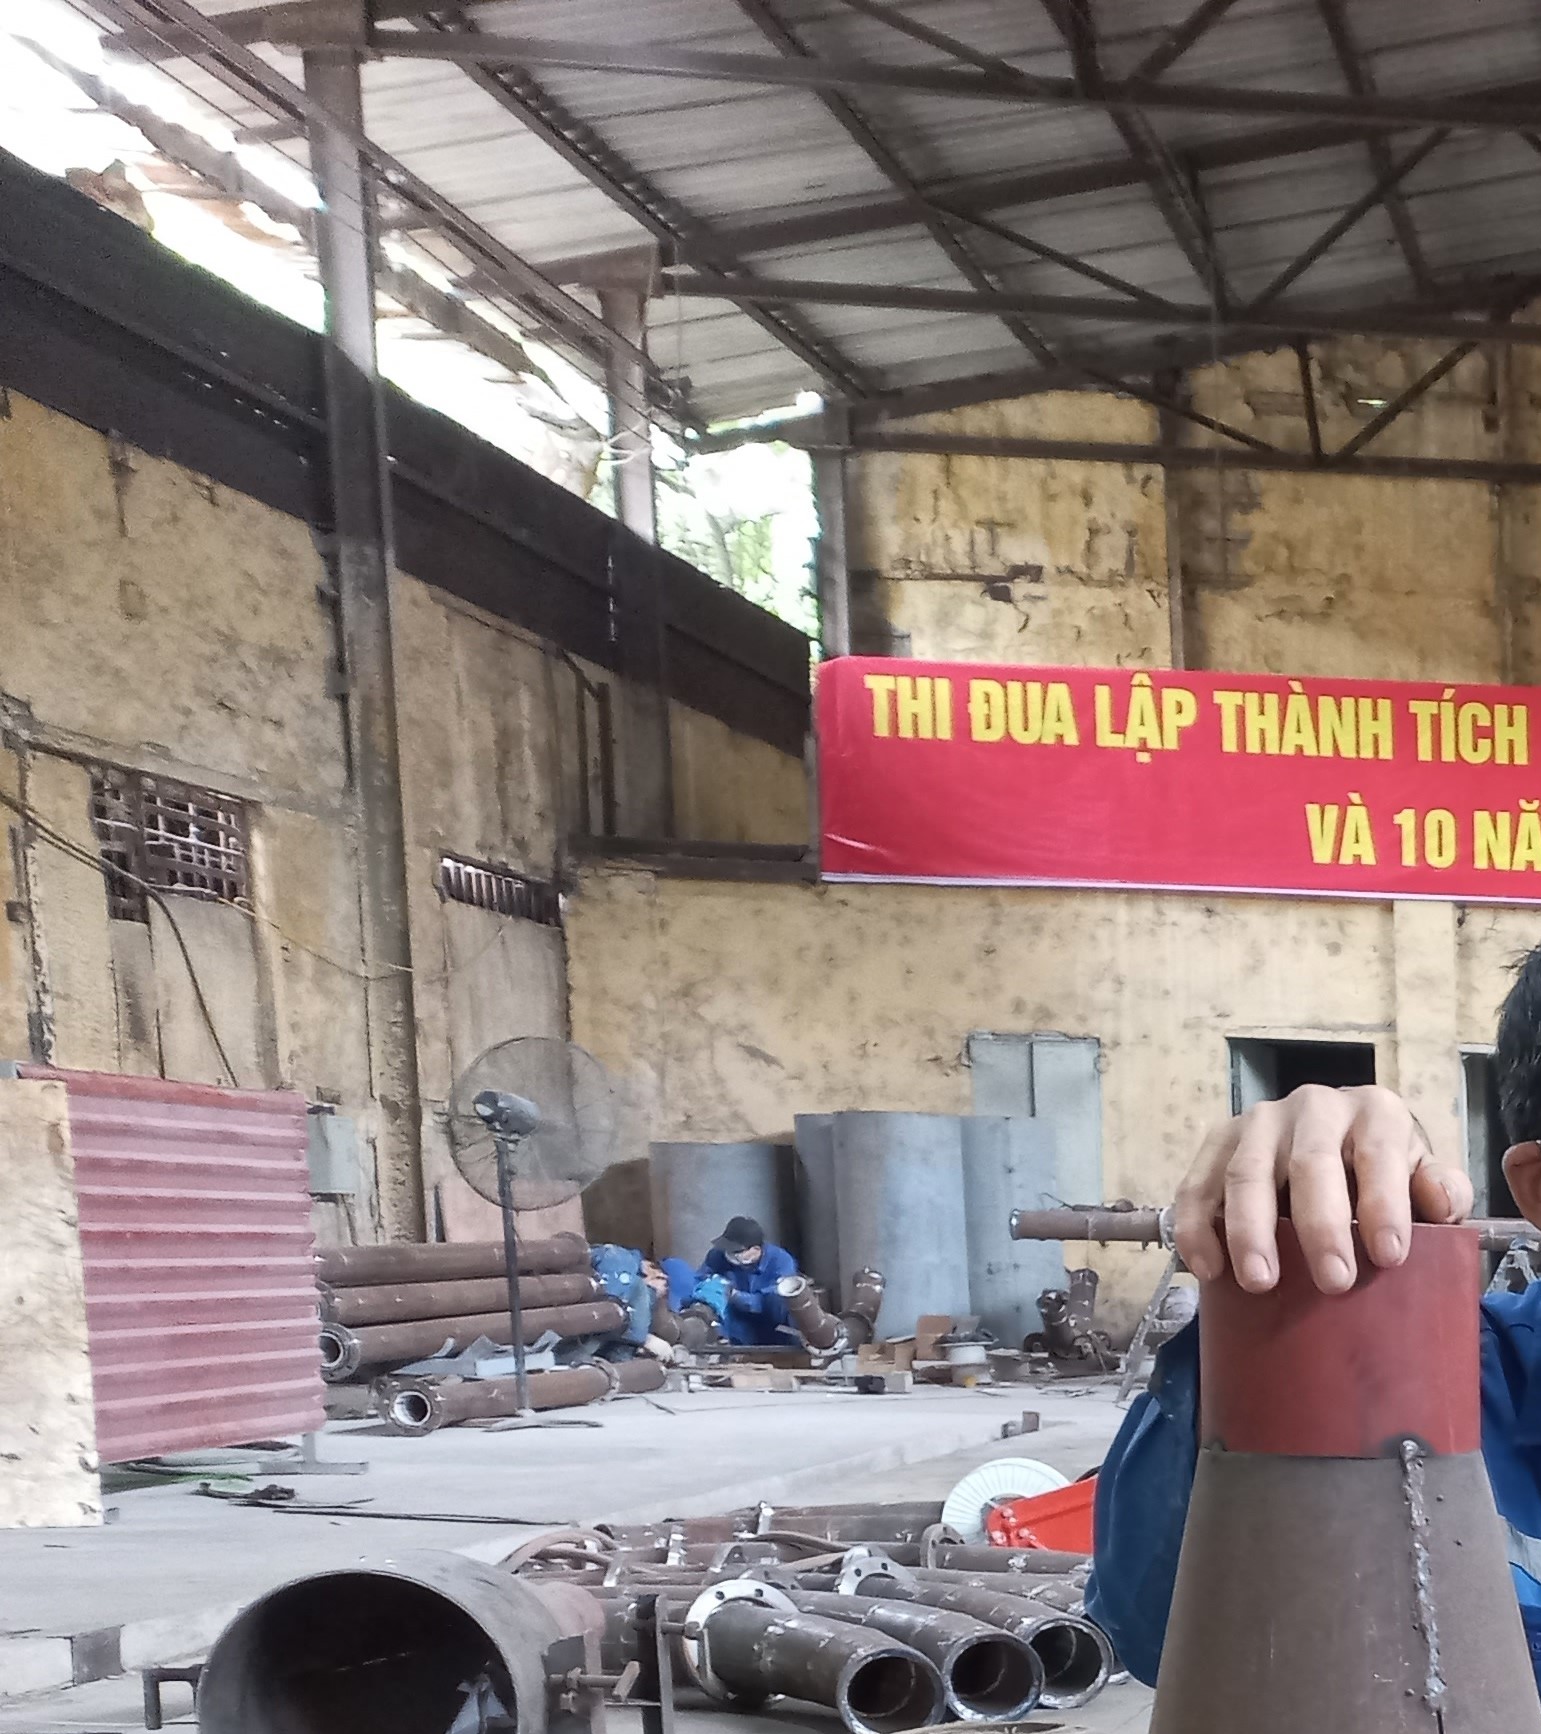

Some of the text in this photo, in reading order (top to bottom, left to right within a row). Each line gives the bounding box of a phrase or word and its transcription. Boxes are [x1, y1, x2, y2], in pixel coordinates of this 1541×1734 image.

[865, 673, 953, 741] THI
[968, 679, 1080, 747] ĐUA
[1094, 672, 1198, 765] LẬP
[1213, 680, 1394, 761] THÀNH
[1408, 687, 1529, 766] TÍCH
[1304, 792, 1376, 867] VÀ
[1393, 807, 1456, 869] 10
